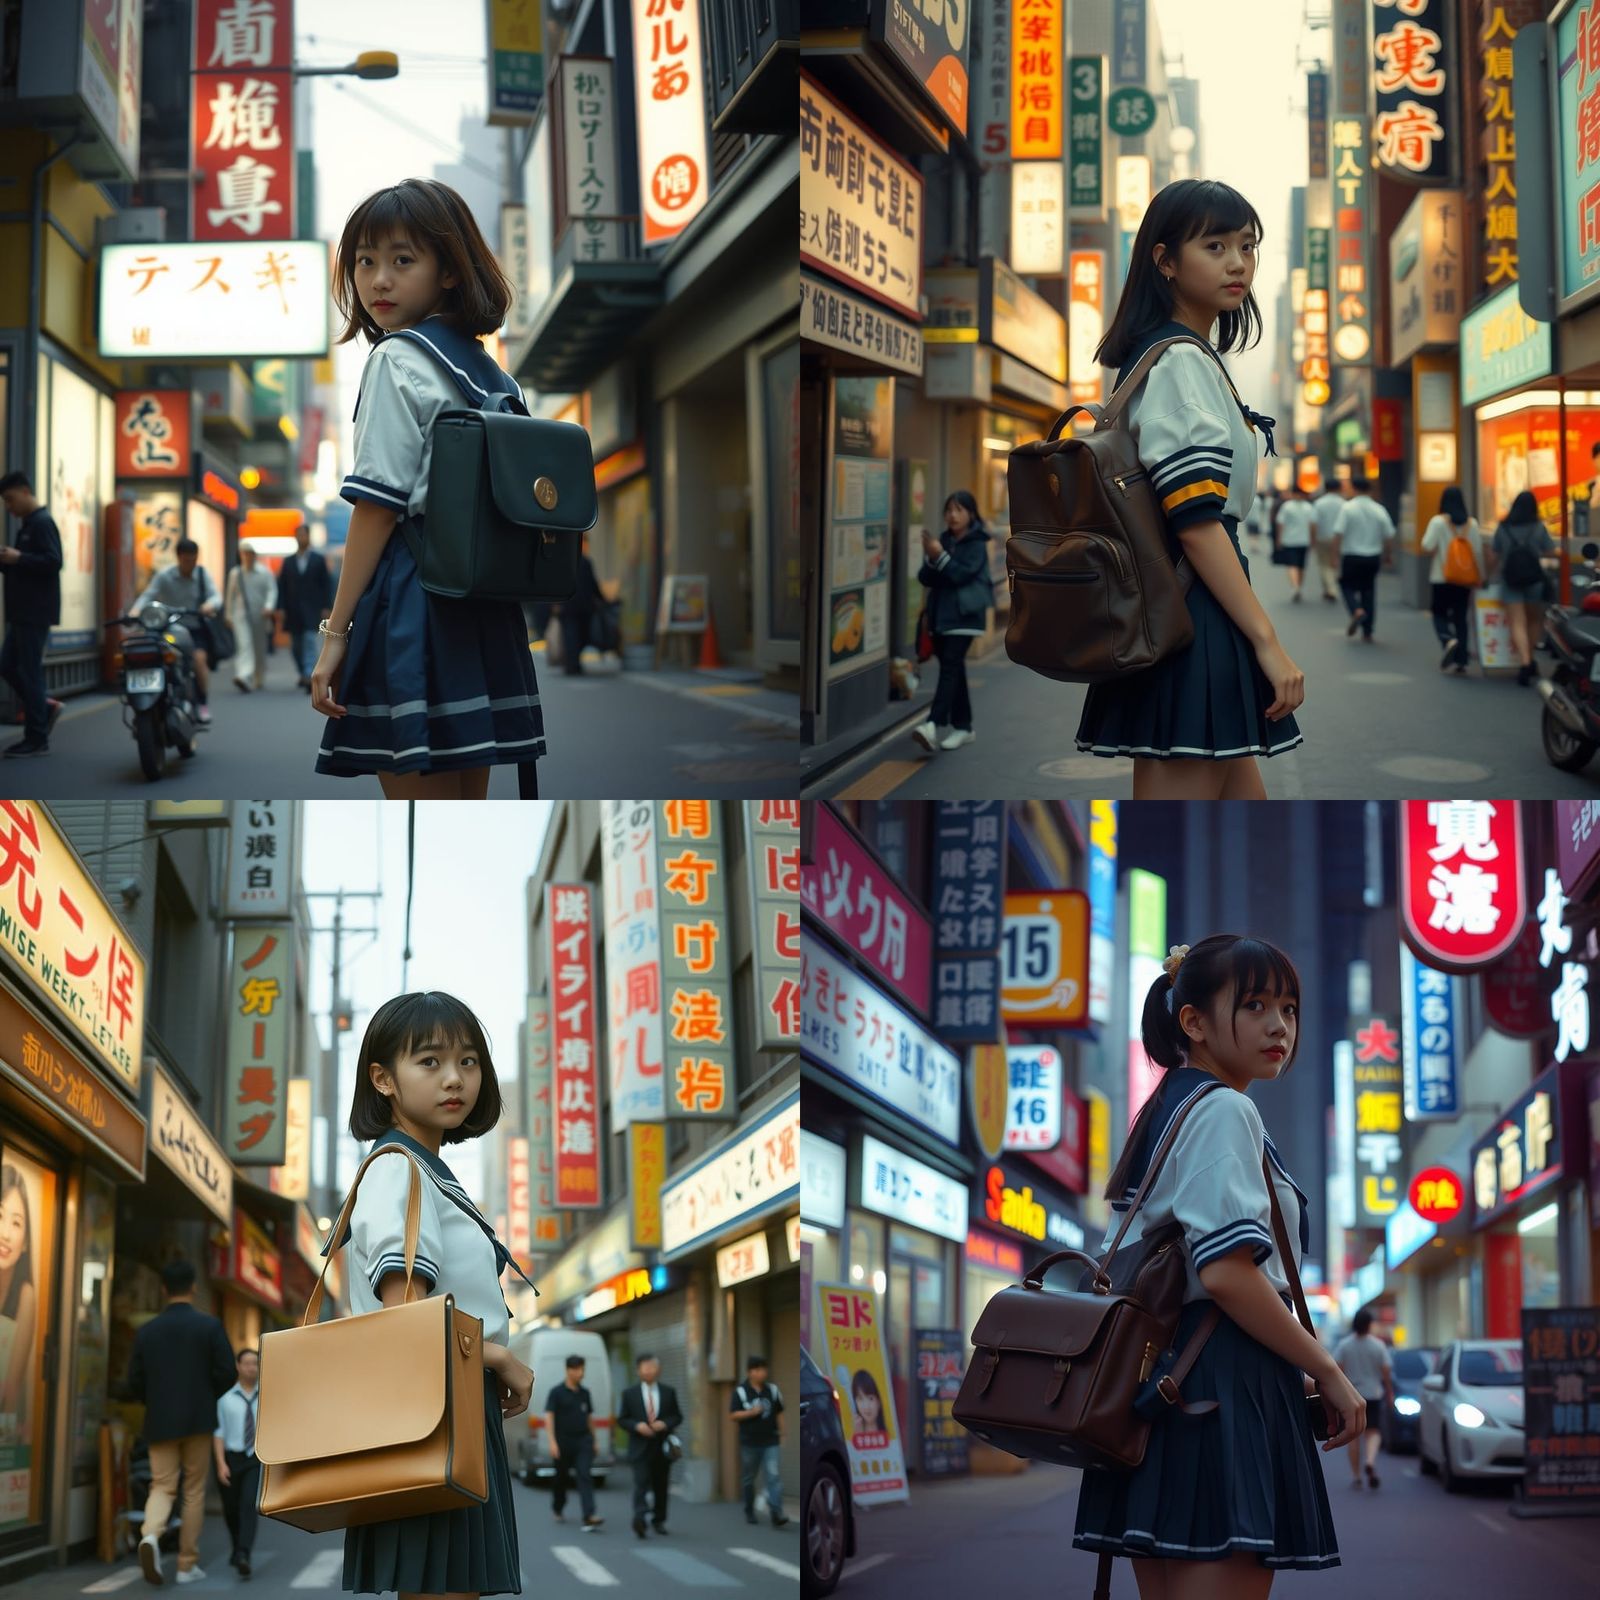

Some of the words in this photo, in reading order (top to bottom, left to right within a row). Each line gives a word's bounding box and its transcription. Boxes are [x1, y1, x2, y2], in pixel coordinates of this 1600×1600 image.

[1073, 65, 1097, 100] 3
[982, 123, 1007, 154] 5
[1002, 925, 1049, 979] 15
